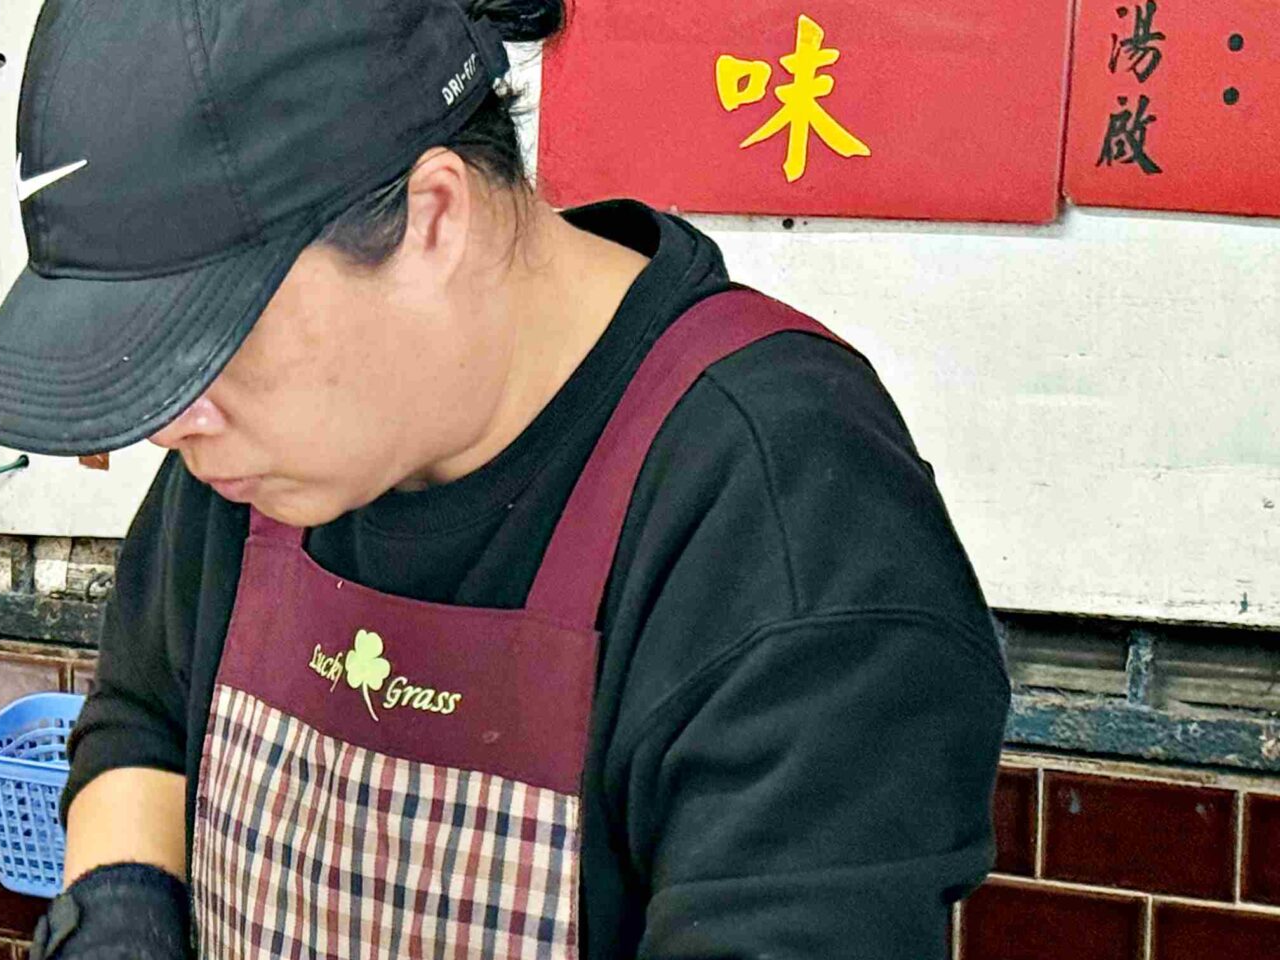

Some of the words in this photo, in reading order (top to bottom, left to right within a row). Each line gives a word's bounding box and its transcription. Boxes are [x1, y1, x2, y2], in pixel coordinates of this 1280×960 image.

[441, 53, 477, 106] DRI-FIT
[716, 14, 872, 183] 味
[308, 643, 343, 693] Lucky
[382, 675, 462, 715] Grass
